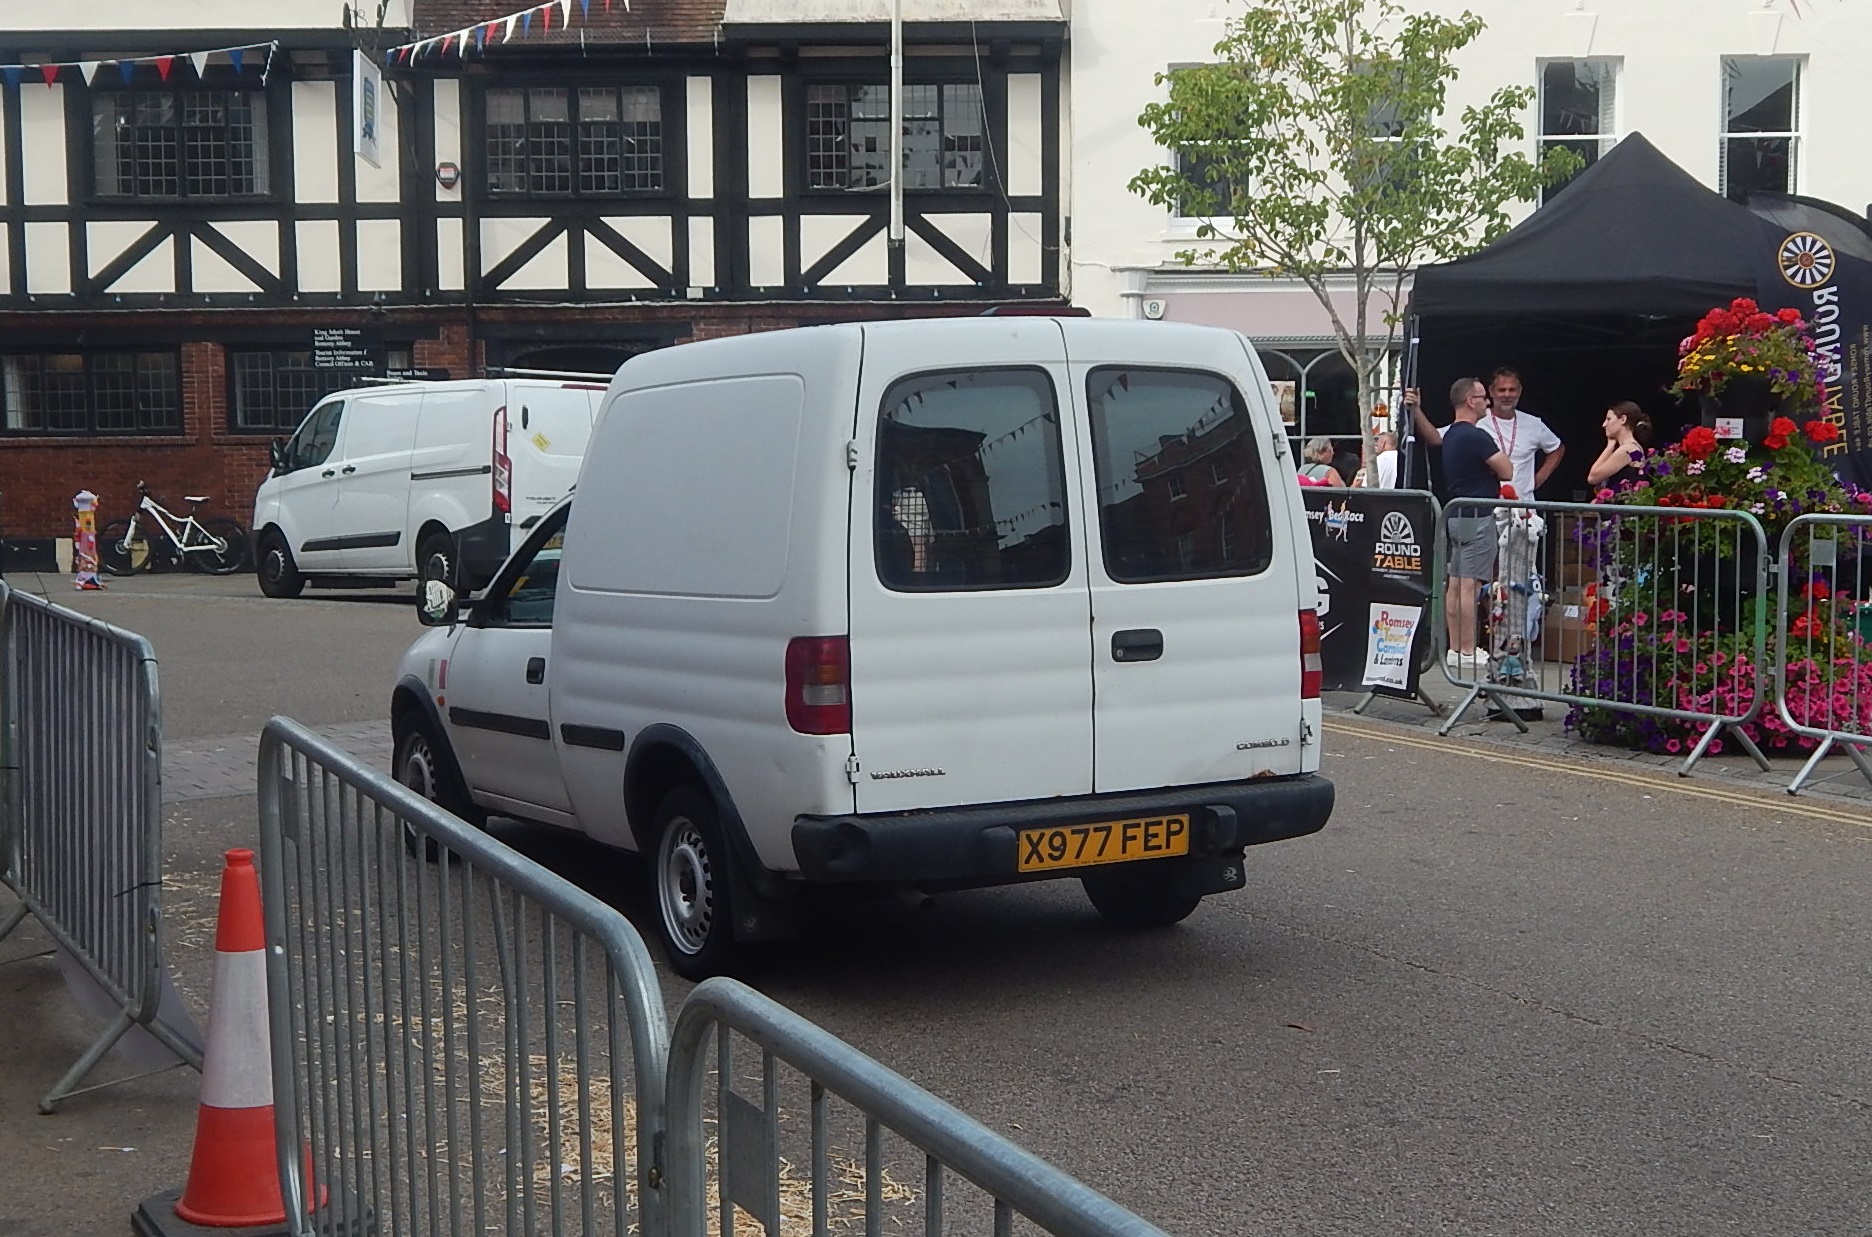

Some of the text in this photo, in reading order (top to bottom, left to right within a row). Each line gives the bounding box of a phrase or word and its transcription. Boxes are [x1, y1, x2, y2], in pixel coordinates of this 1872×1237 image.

[1305, 510, 1324, 525] msey
[1345, 510, 1364, 522] Race
[1375, 542, 1421, 556] ROUND
[1374, 554, 1422, 570] TABLE
[1381, 610, 1415, 629] Romsey
[1383, 627, 1406, 643] Town
[1373, 653, 1379, 665] &
[870, 767, 946, 780] VAUXHALL
[1024, 818, 1185, 865] X977 FEP
